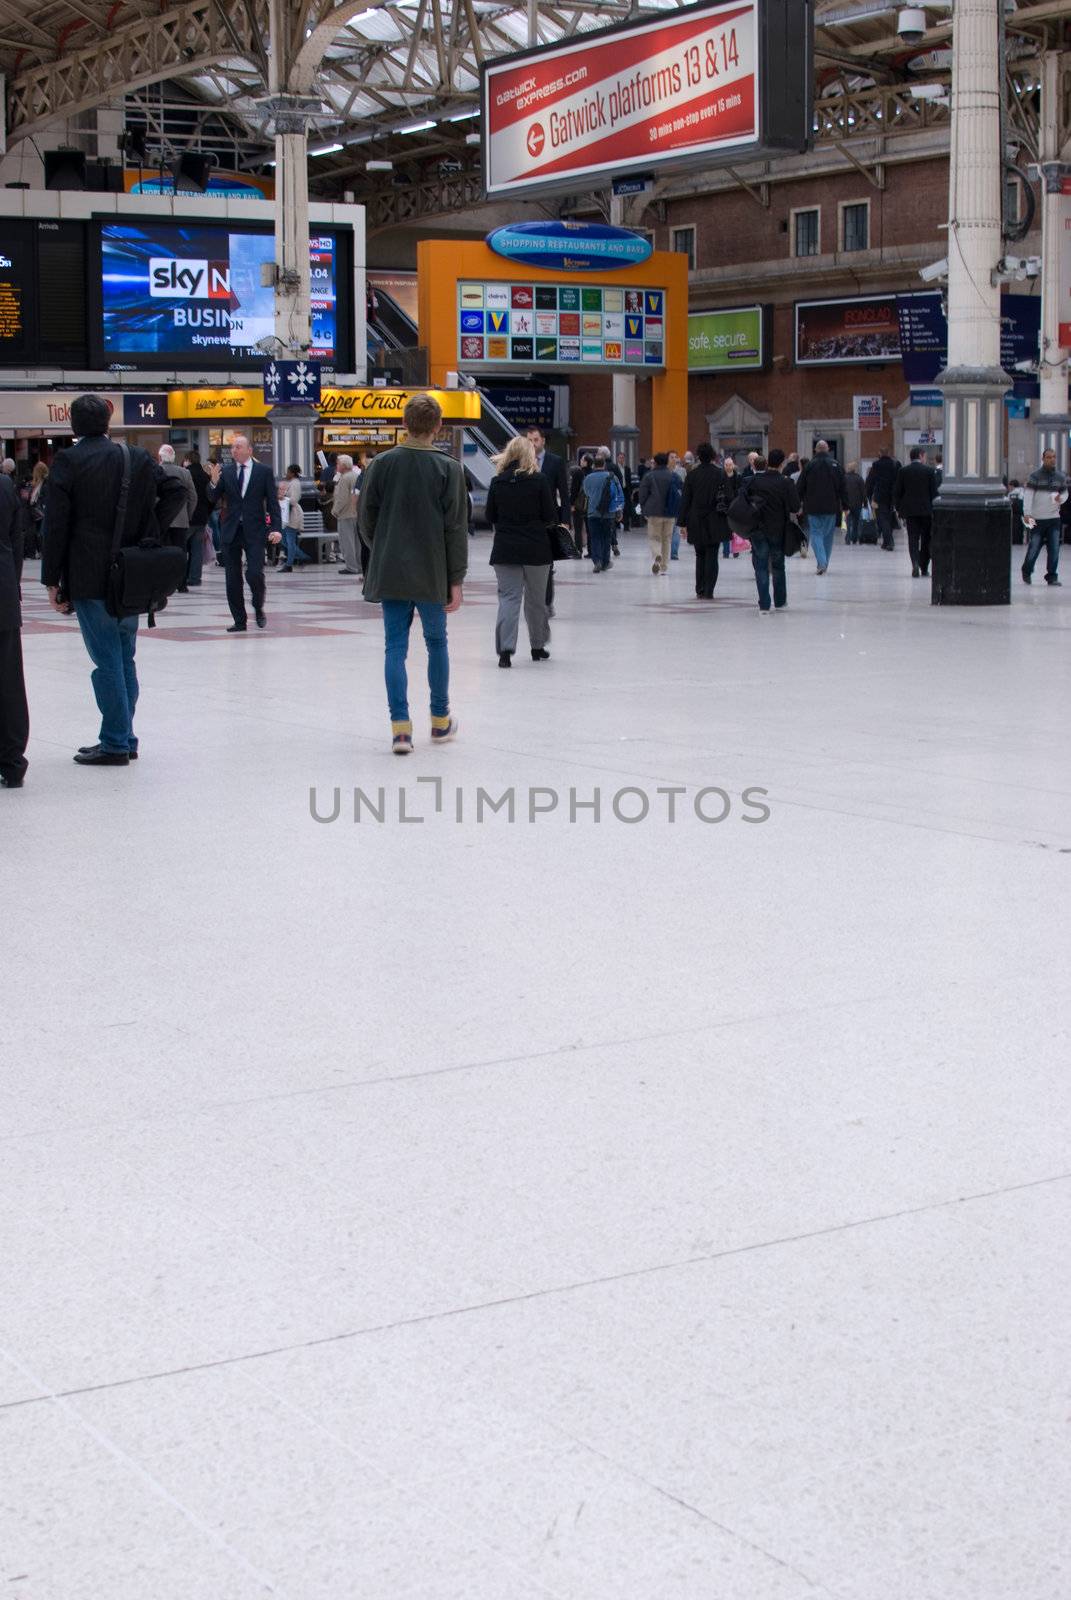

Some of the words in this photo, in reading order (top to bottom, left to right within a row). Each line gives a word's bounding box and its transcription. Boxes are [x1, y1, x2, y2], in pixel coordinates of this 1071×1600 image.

[550, 91, 607, 147] Gatwick
[608, 62, 682, 127] platforms
[684, 45, 701, 87] 13
[705, 38, 719, 78] &
[721, 28, 739, 71] 14
[649, 127, 658, 141] 30
[658, 122, 673, 138] mins
[673, 110, 700, 131] non-stop
[700, 103, 717, 121] every
[718, 101, 725, 113] 15
[726, 93, 742, 110] mins
[320, 239, 332, 248] HD
[501, 239, 546, 250] SHOPPING
[548, 240, 606, 251] RESTAURANTS
[608, 243, 624, 252] AND
[626, 246, 645, 254] BARS
[153, 261, 205, 296] sky
[323, 330, 332, 340] C
[689, 332, 713, 351] safe,
[713, 331, 749, 347] secure.
[513, 344, 532, 353] next
[195, 398, 220, 411] Upper
[220, 397, 245, 409] Crust
[361, 392, 408, 410] Crust
[138, 402, 156, 419] 14
